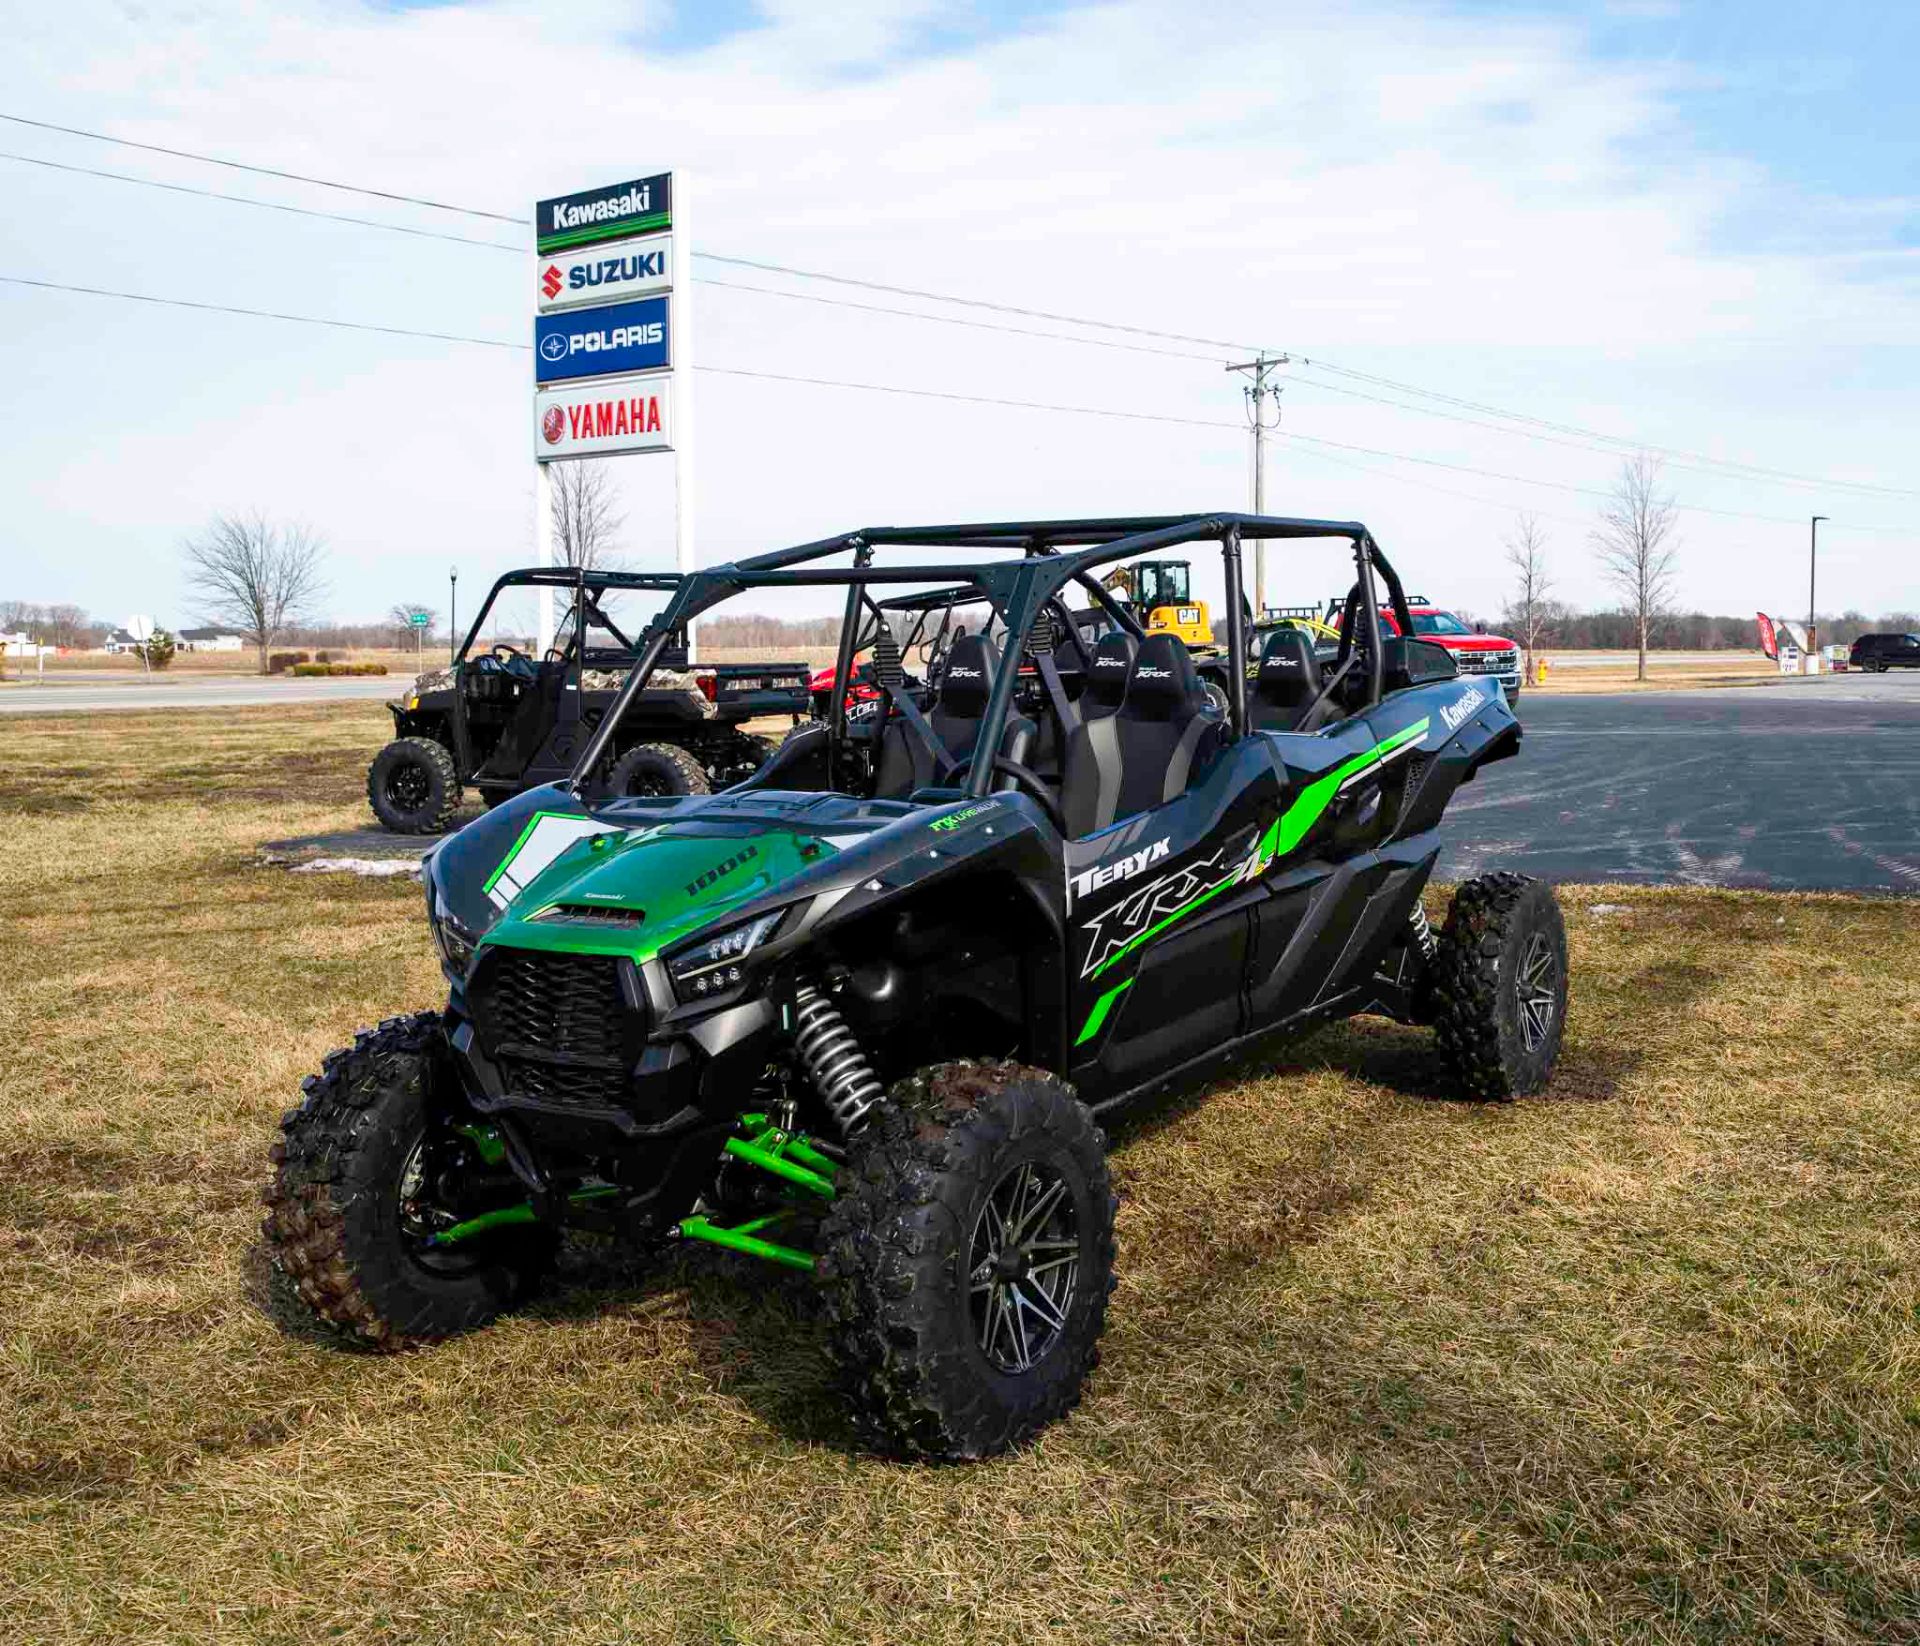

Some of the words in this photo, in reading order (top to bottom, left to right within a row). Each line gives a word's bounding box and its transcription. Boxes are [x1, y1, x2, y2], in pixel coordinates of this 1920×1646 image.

[553, 185, 650, 230] Kawasaki
[569, 251, 665, 289] SUZUKI
[569, 322, 664, 354] POLARIS
[568, 396, 661, 440] YAMAHA
[1178, 608, 1199, 624] CAT
[948, 670, 982, 678] KRX
[1135, 670, 1172, 679] KRX
[1440, 685, 1485, 730] Kawasaki
[685, 845, 758, 897] 1000
